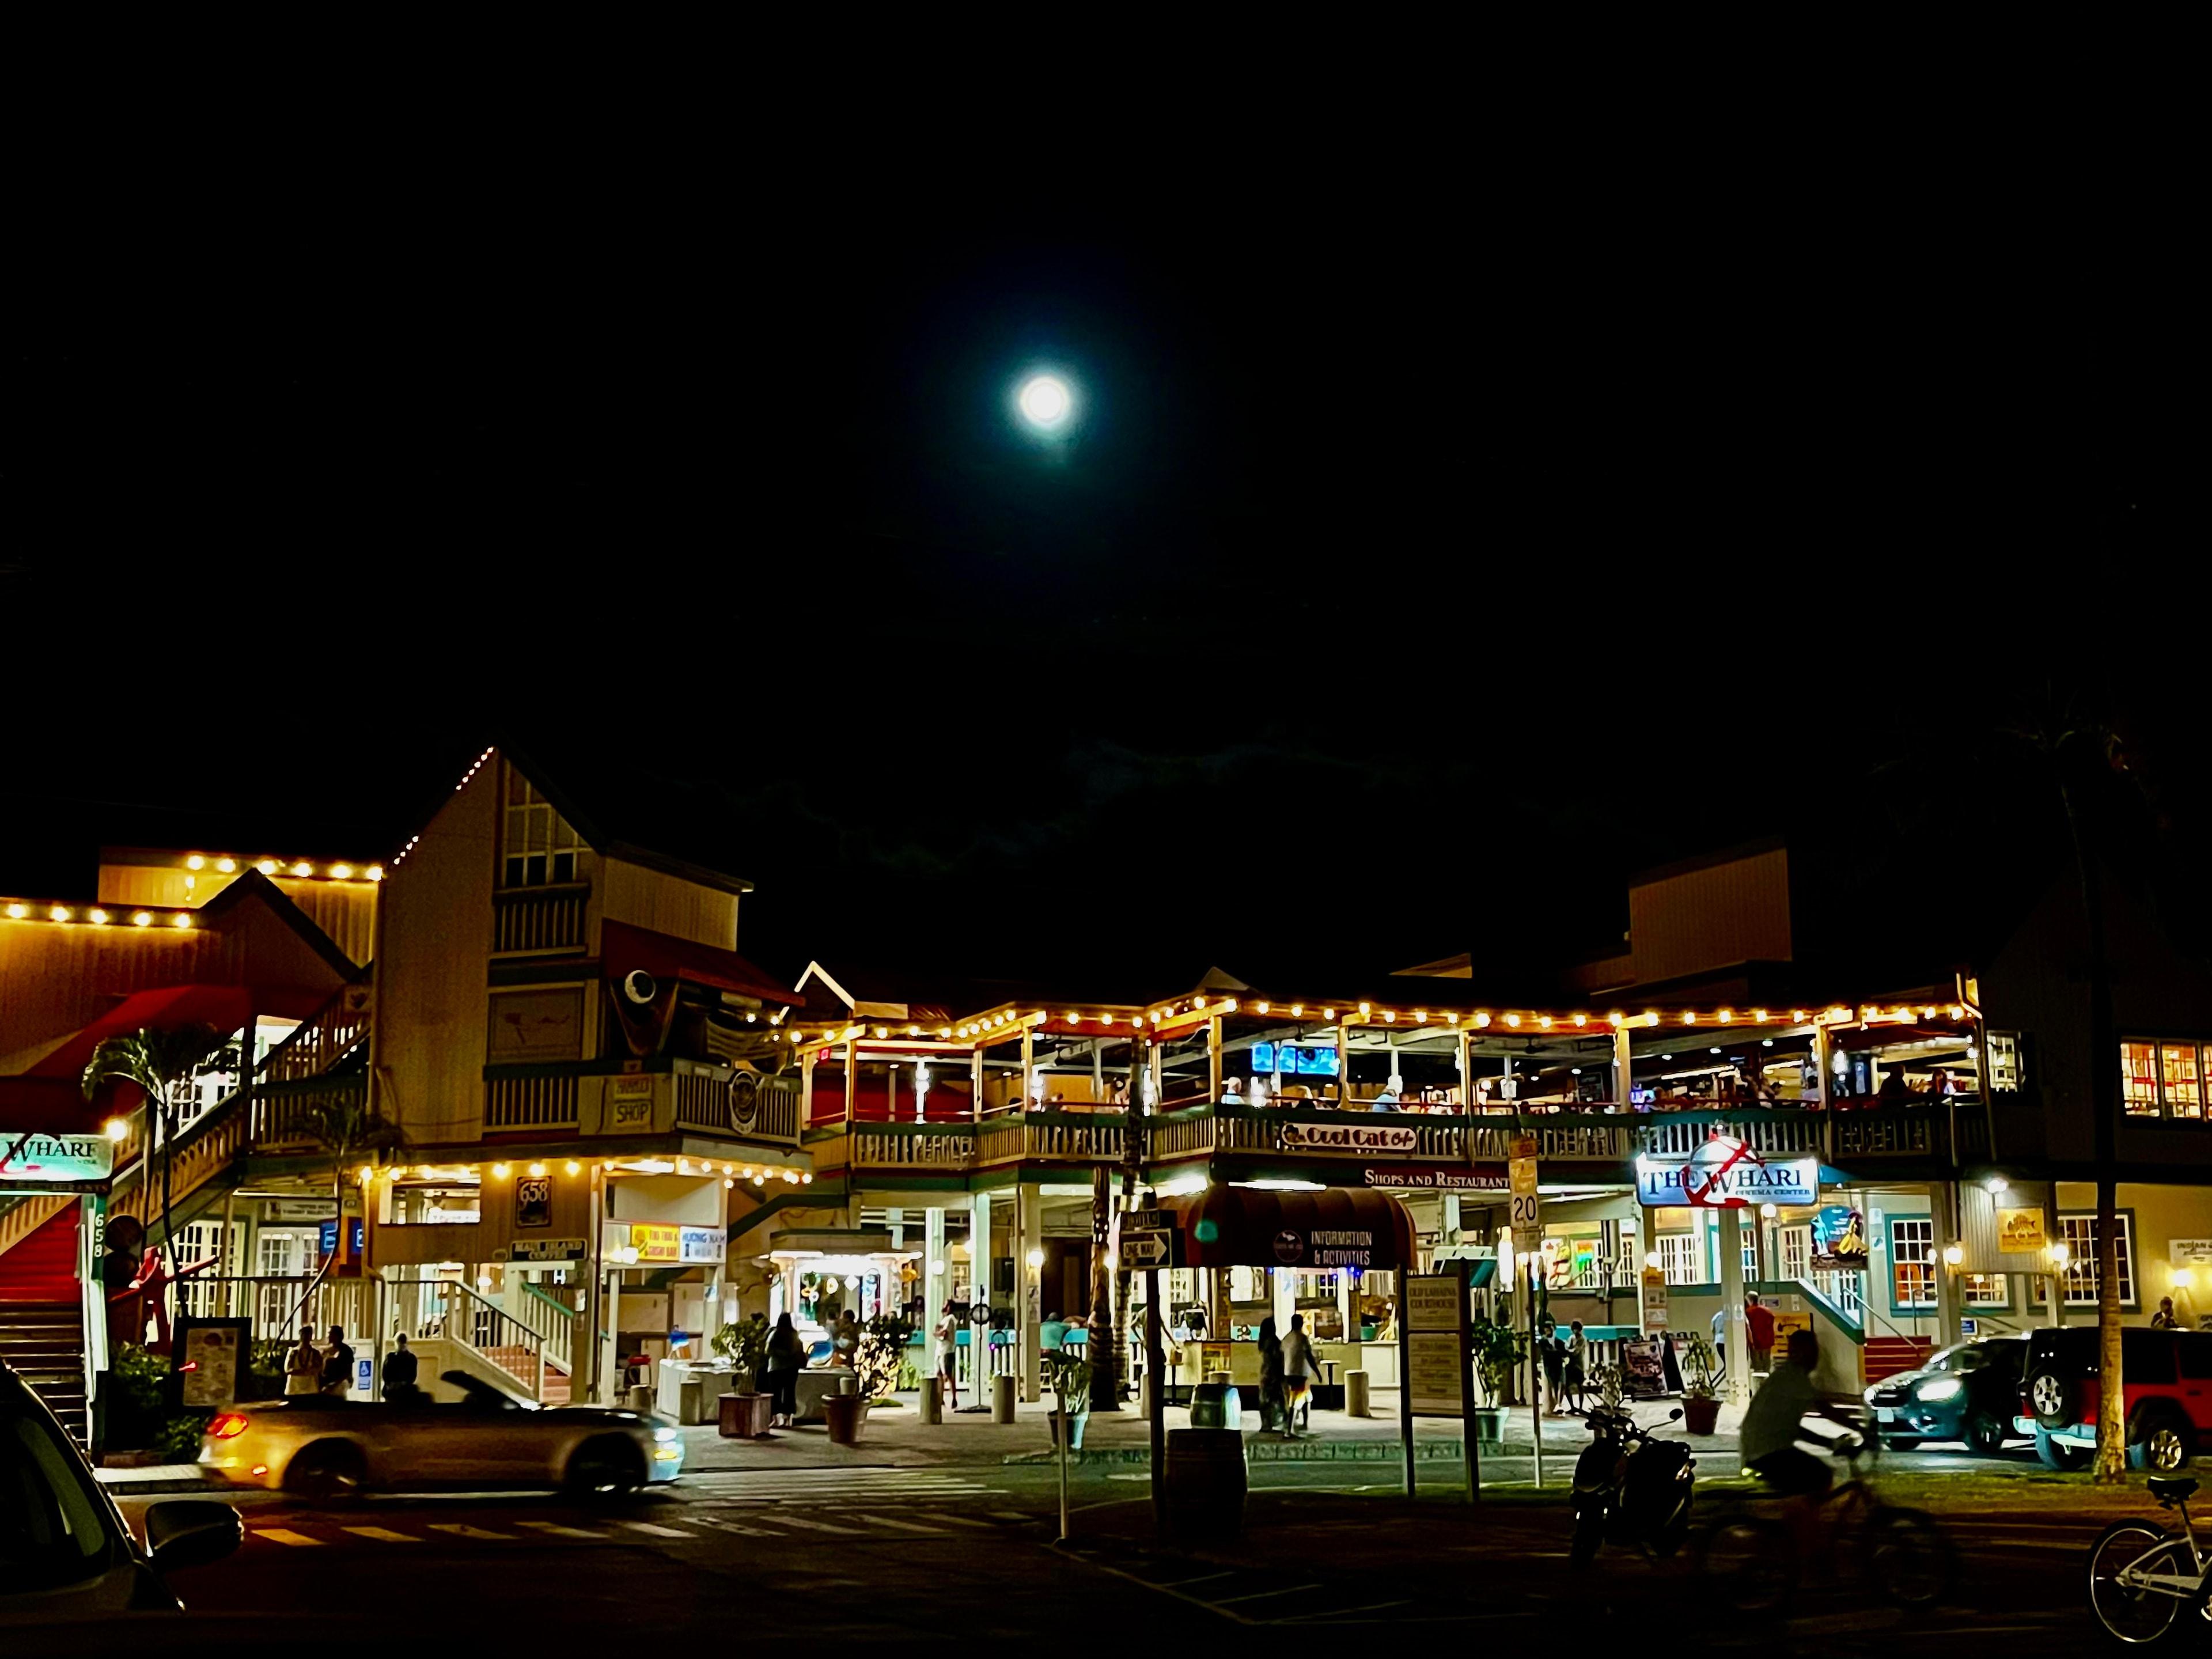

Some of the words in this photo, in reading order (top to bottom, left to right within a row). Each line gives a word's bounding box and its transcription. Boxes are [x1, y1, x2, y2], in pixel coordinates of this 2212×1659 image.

[617, 1104, 649, 1123] SHOP
[1306, 1127, 1350, 1145] Cool
[1353, 1129, 1389, 1146] Cat
[1365, 1169, 1404, 1185] SHOPS
[1407, 1175, 1433, 1186] AND
[1435, 1172, 1510, 1188] RESTAURANT
[1643, 1171, 1699, 1195] THE
[521, 1181, 547, 1204] 658
[1514, 1195, 1536, 1222] 20
[94, 1213, 104, 1257] 658
[1311, 1230, 1372, 1246] INFORMATION
[1124, 1243, 1139, 1256] ONE
[1141, 1243, 1155, 1256] WAY
[1315, 1249, 1320, 1264] &
[1323, 1250, 1370, 1266] ACTIVITIES
